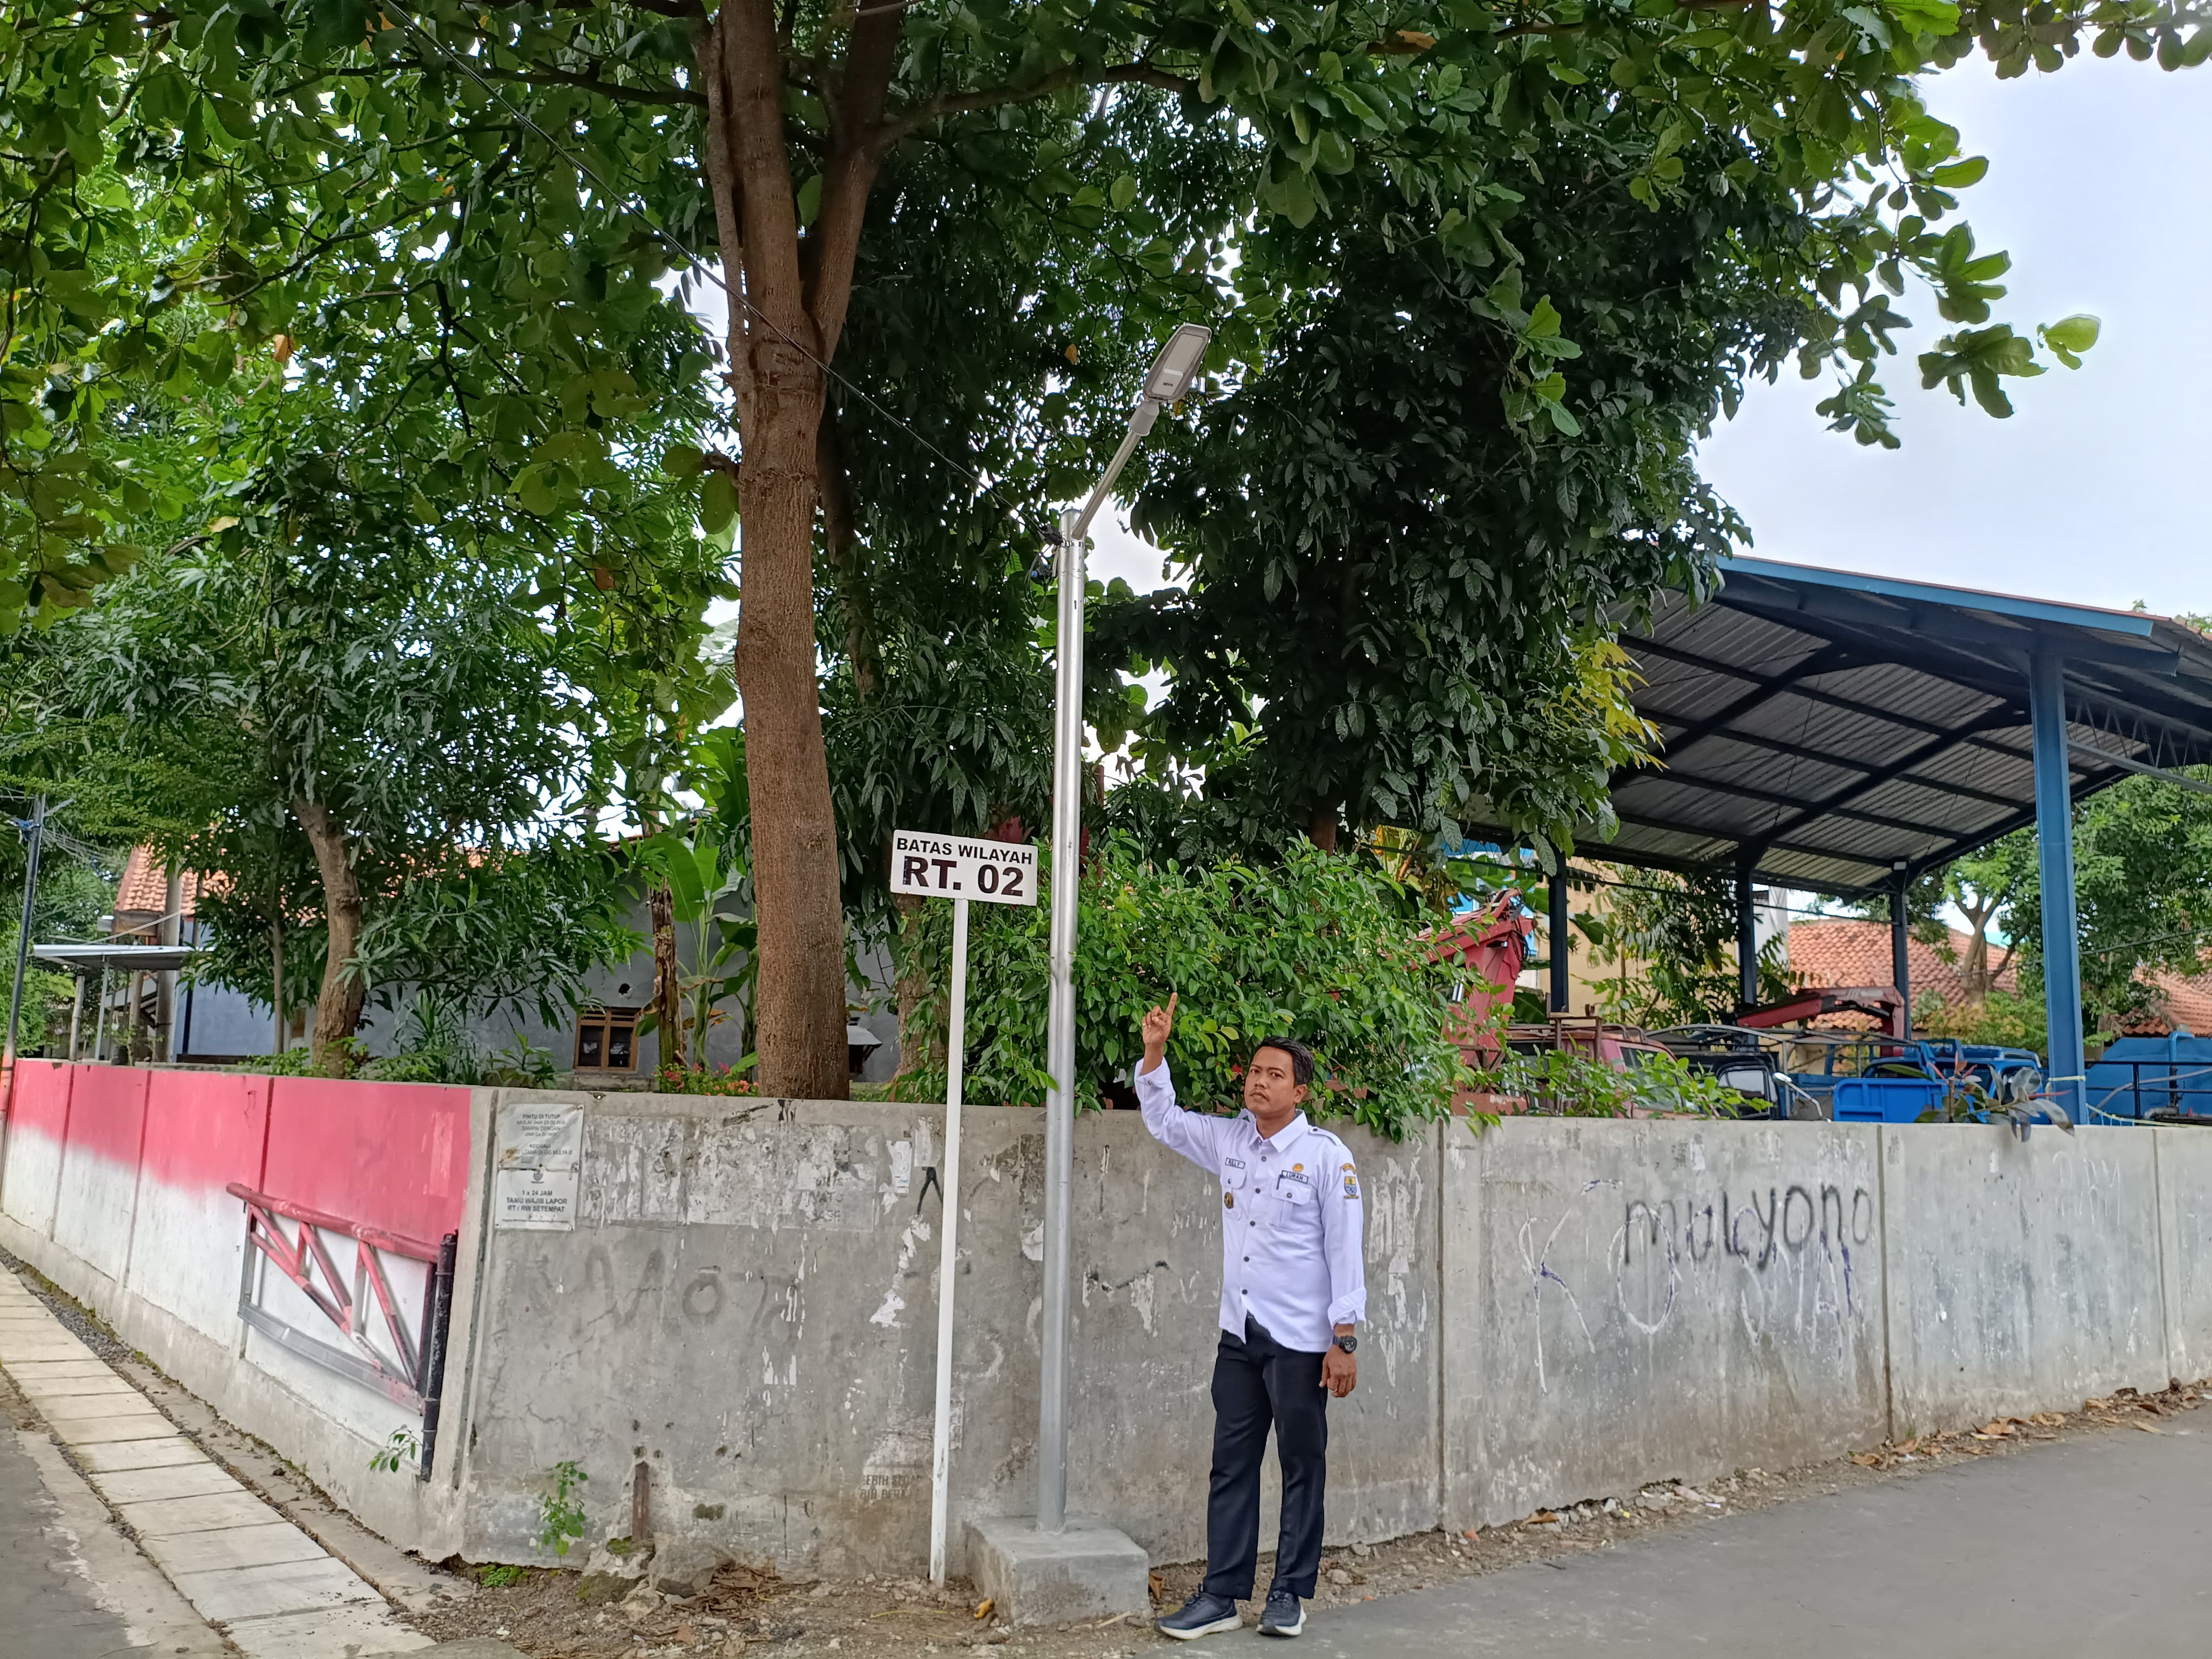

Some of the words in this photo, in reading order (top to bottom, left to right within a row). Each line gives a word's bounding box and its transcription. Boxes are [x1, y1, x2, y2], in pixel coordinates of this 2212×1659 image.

[897, 838, 952, 855] BATAS
[958, 845, 1032, 865] WILAYAH
[902, 855, 962, 891] RT.
[977, 864, 1024, 896] 02
